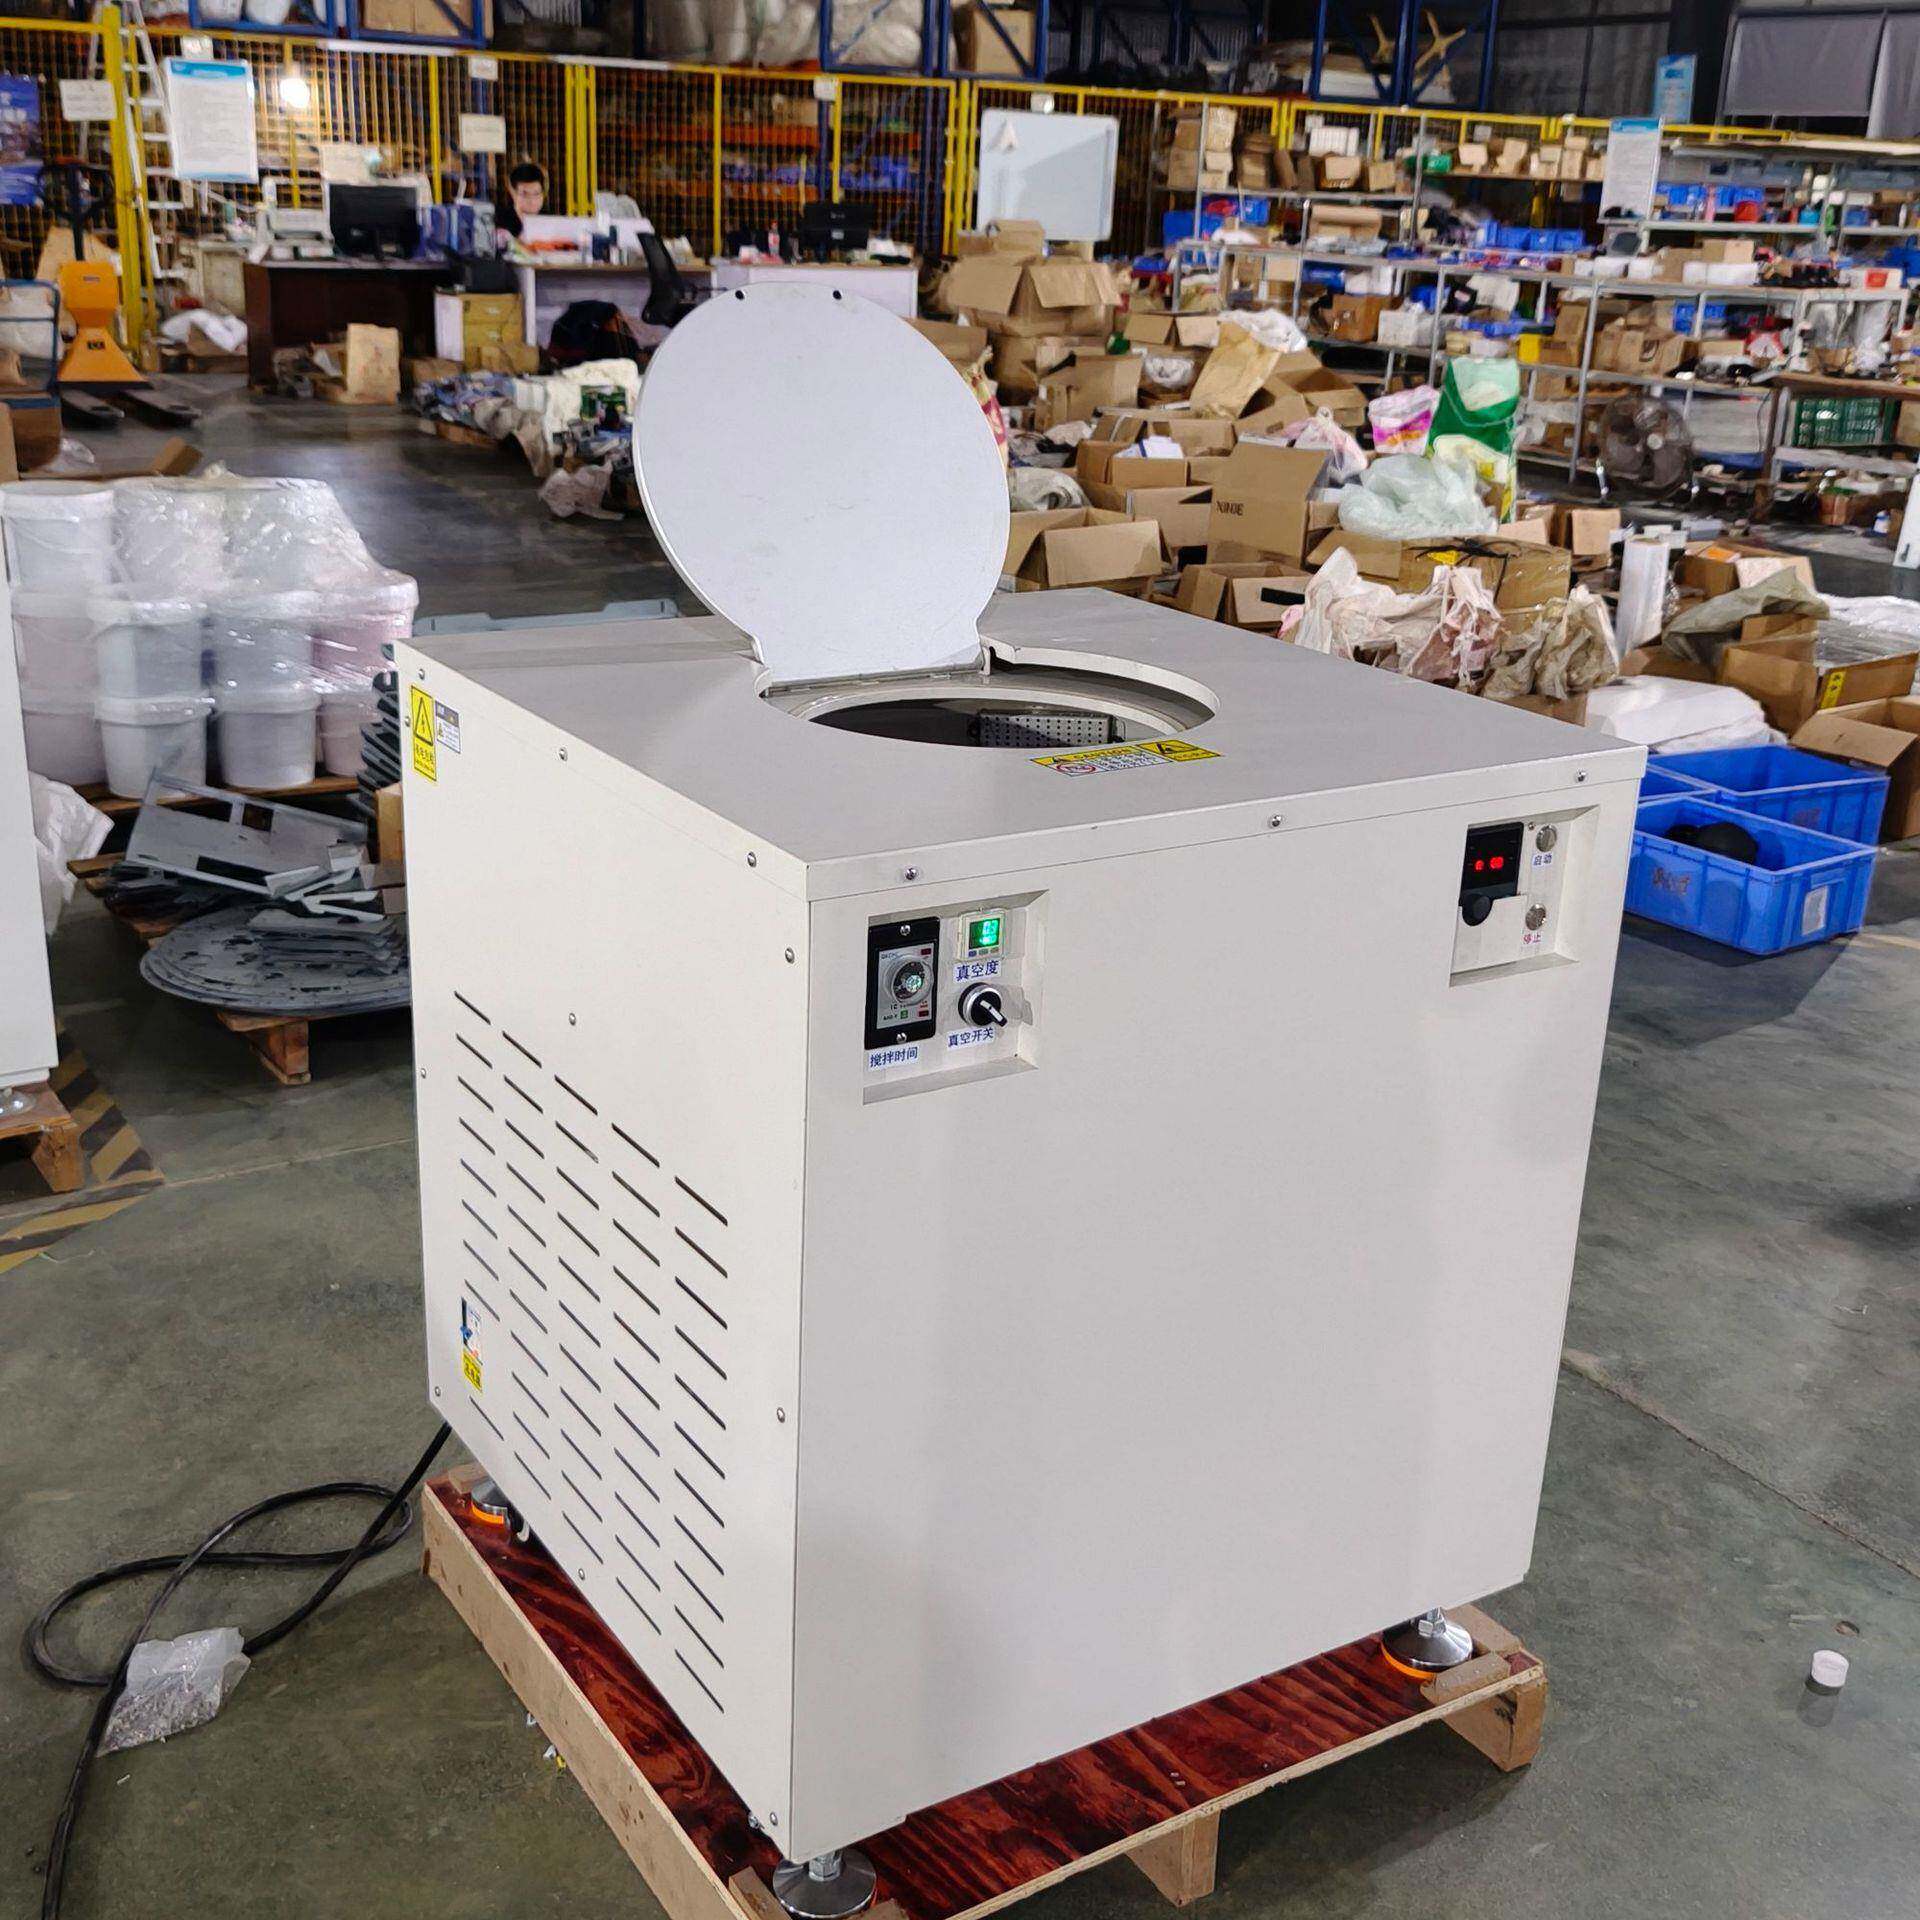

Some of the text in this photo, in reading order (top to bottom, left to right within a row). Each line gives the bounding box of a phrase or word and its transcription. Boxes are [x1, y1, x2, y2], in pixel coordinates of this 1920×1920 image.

[956, 960, 999, 982] 真空度
[948, 1027, 994, 1047] 真空开关
[870, 1046, 918, 1068] 搅拌时间
